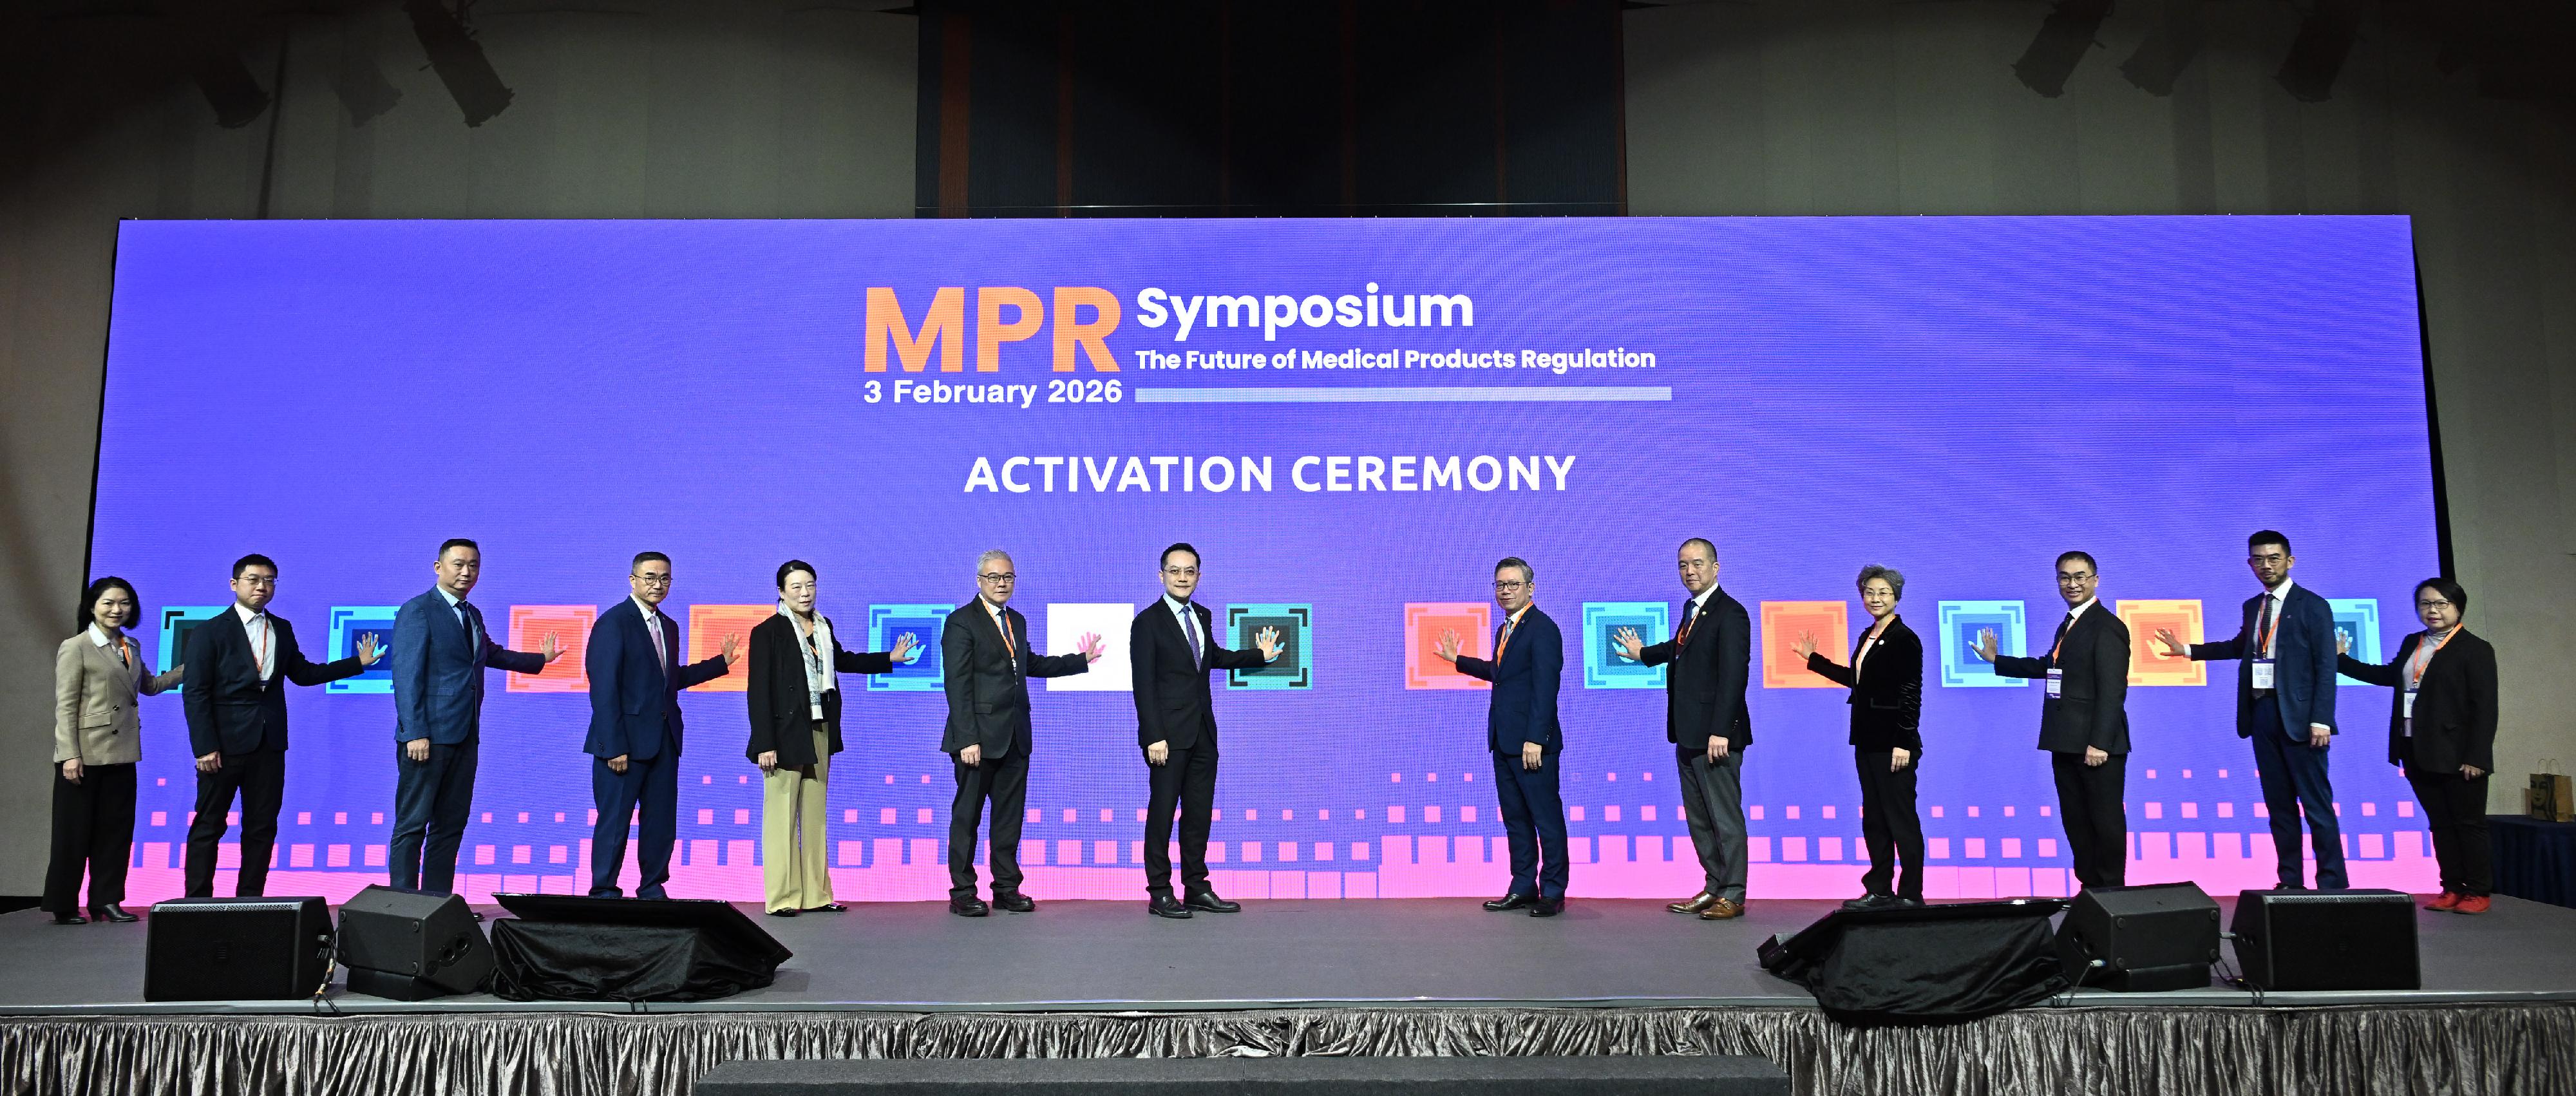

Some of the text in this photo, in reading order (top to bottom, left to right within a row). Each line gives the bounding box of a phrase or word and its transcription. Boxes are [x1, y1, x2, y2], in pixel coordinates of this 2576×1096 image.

[864, 281, 1473, 373] MPR Symposium
[1135, 346, 1656, 375] The Future of Medical Products Regulation
[864, 379, 1122, 409] 3 February 2026
[963, 455, 1576, 493] ACTIVATION CEREMONY
